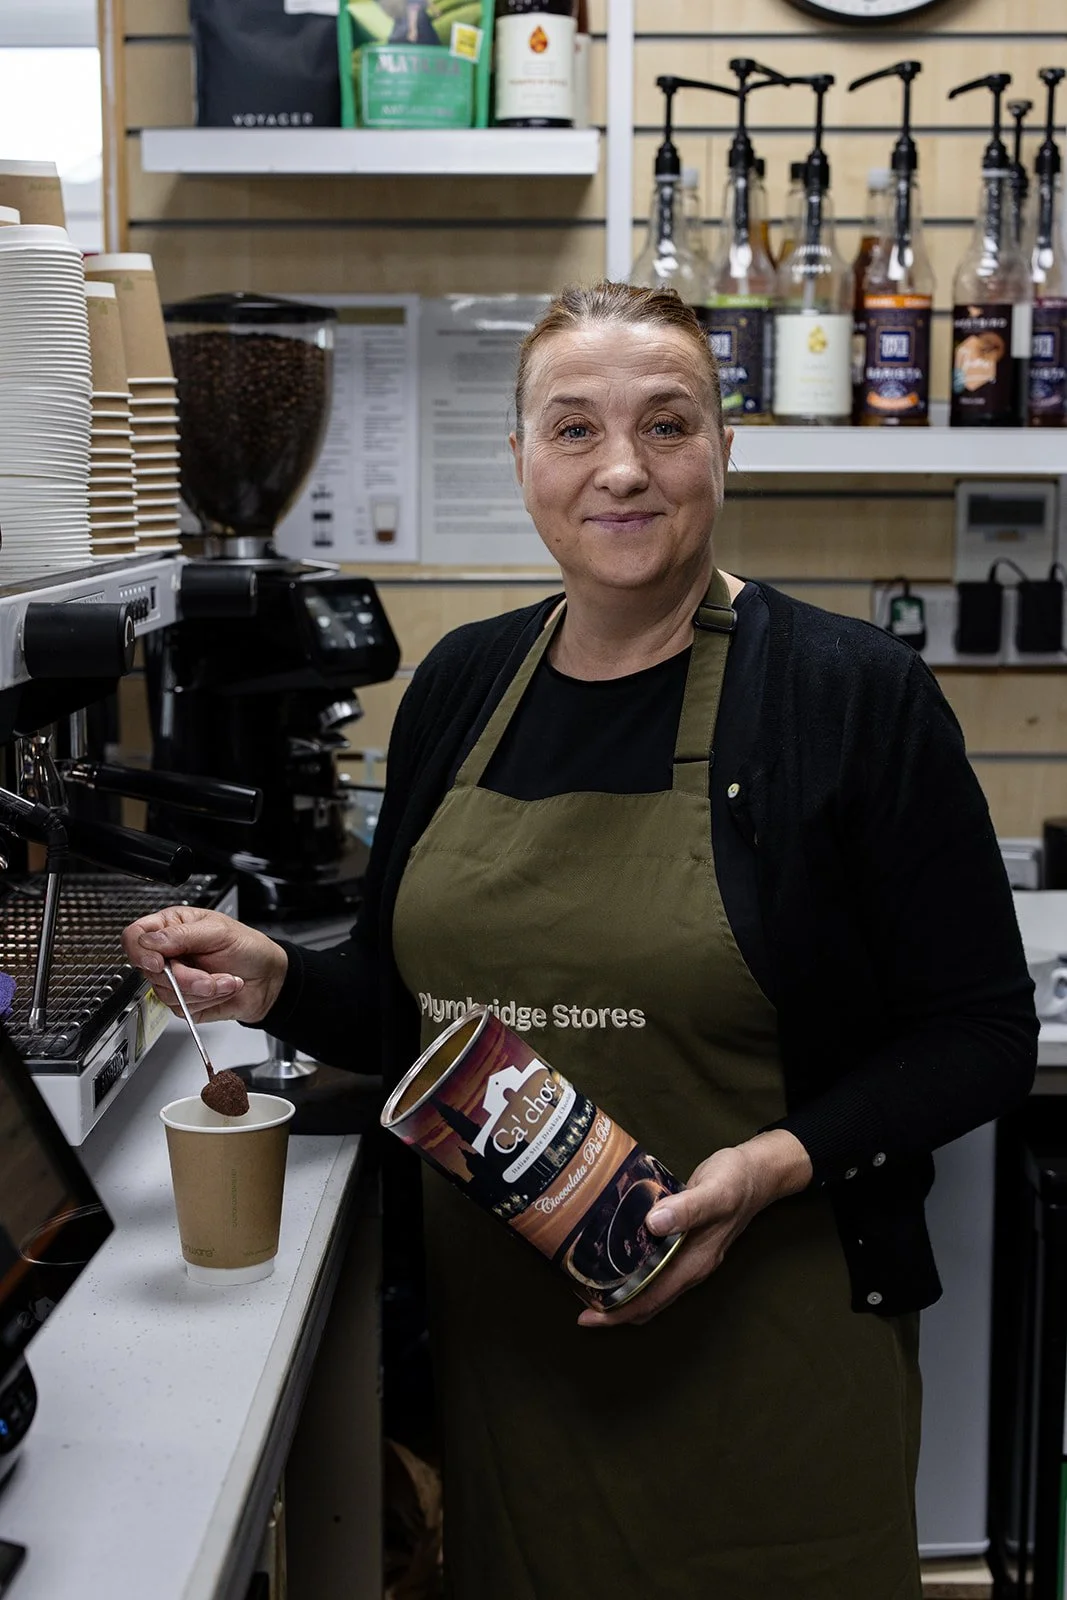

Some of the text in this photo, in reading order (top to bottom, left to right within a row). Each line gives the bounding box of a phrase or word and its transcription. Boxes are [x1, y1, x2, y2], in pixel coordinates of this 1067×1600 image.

[232, 112, 314, 126] VOYAGER
[552, 1004, 647, 1029] Stores
[542, 1115, 563, 1140] Drinking
